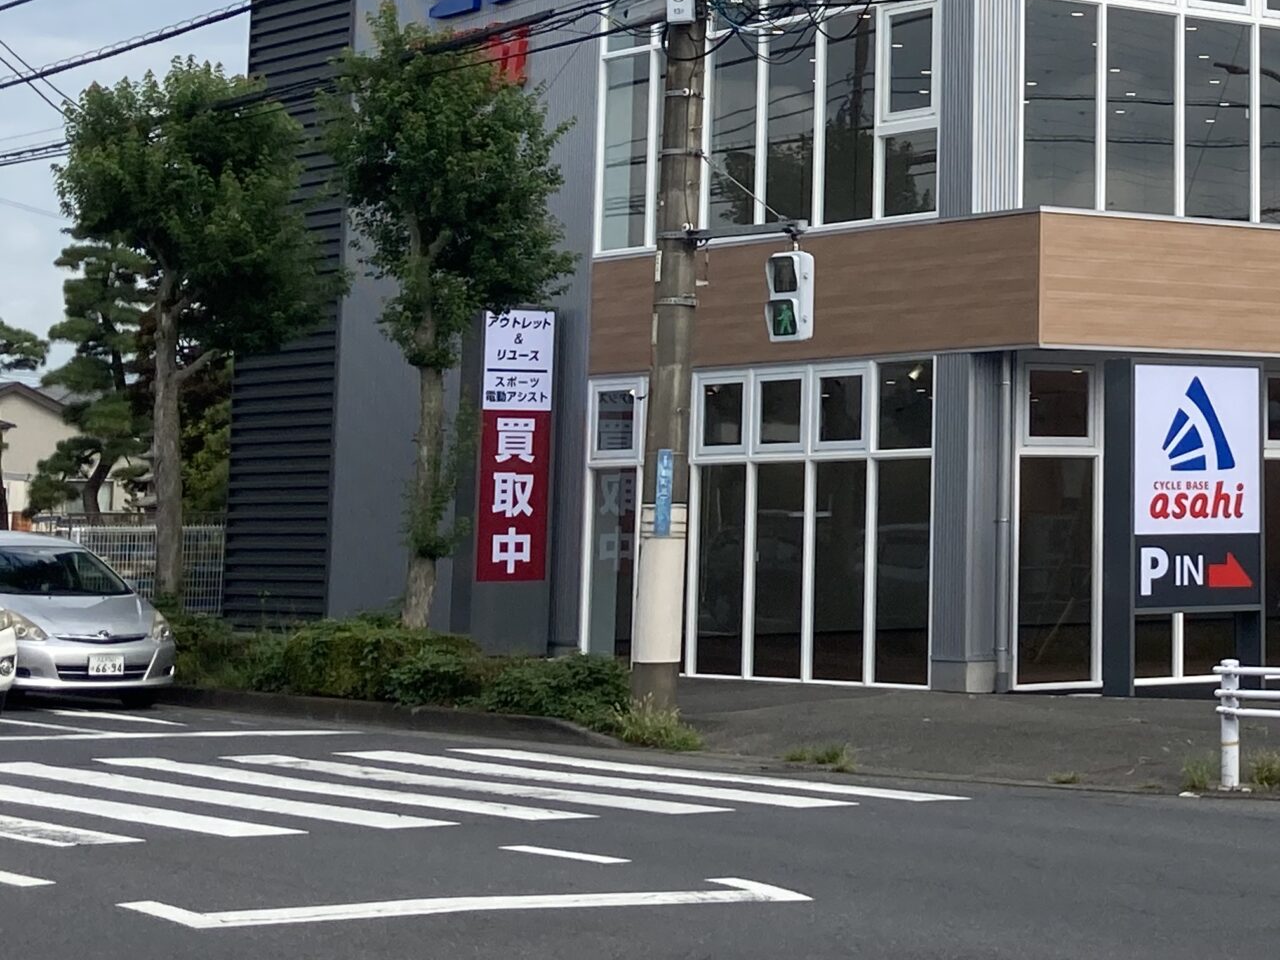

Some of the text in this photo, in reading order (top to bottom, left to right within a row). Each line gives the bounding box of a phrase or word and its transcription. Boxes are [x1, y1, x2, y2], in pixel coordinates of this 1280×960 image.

[488, 316, 551, 330] アウトレット
[514, 333, 523, 344] &
[497, 349, 539, 361] リユース
[495, 376, 539, 388] スポーツ
[486, 390, 548, 403] 電動アシスト
[1153, 480, 1209, 490] CYCLE BASE
[492, 417, 535, 574] 買取中
[1150, 481, 1244, 519] asahi
[1140, 547, 1203, 596] P IN
